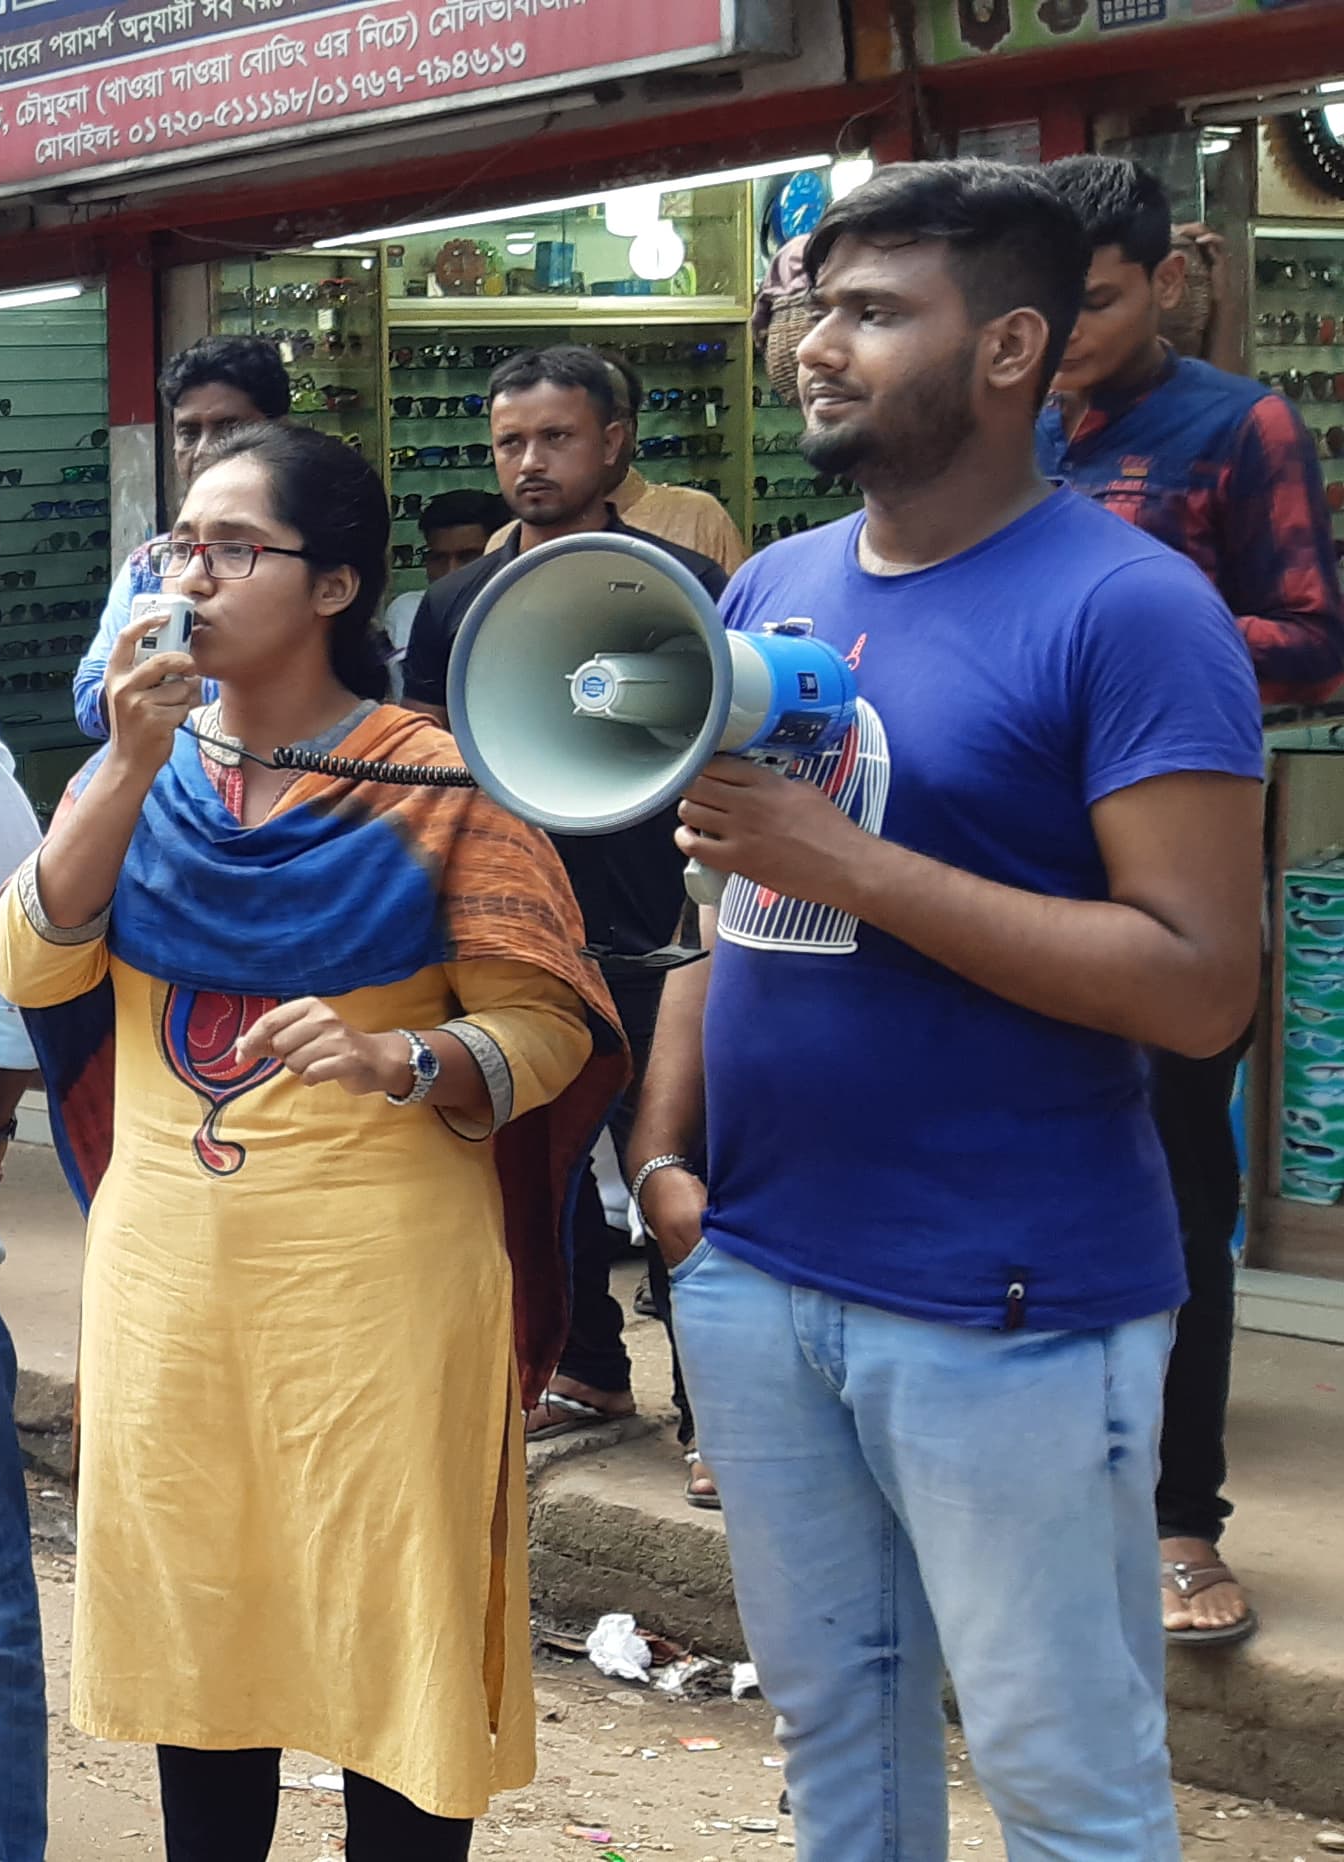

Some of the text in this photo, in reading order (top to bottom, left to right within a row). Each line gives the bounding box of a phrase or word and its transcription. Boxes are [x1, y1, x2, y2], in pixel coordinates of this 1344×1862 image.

[49, 12, 113, 59] পরামর্শ
[119, 0, 194, 43] অনুযায়ী
[16, 86, 89, 128] চৌমুহনা
[96, 73, 164, 116] (খাওয়া
[170, 54, 232, 91] দাওয়া
[239, 34, 308, 78] বোডিং
[314, 31, 350, 60] এর
[357, 12, 419, 51] নিচে)
[35, 123, 120, 164] মোবাইল:
